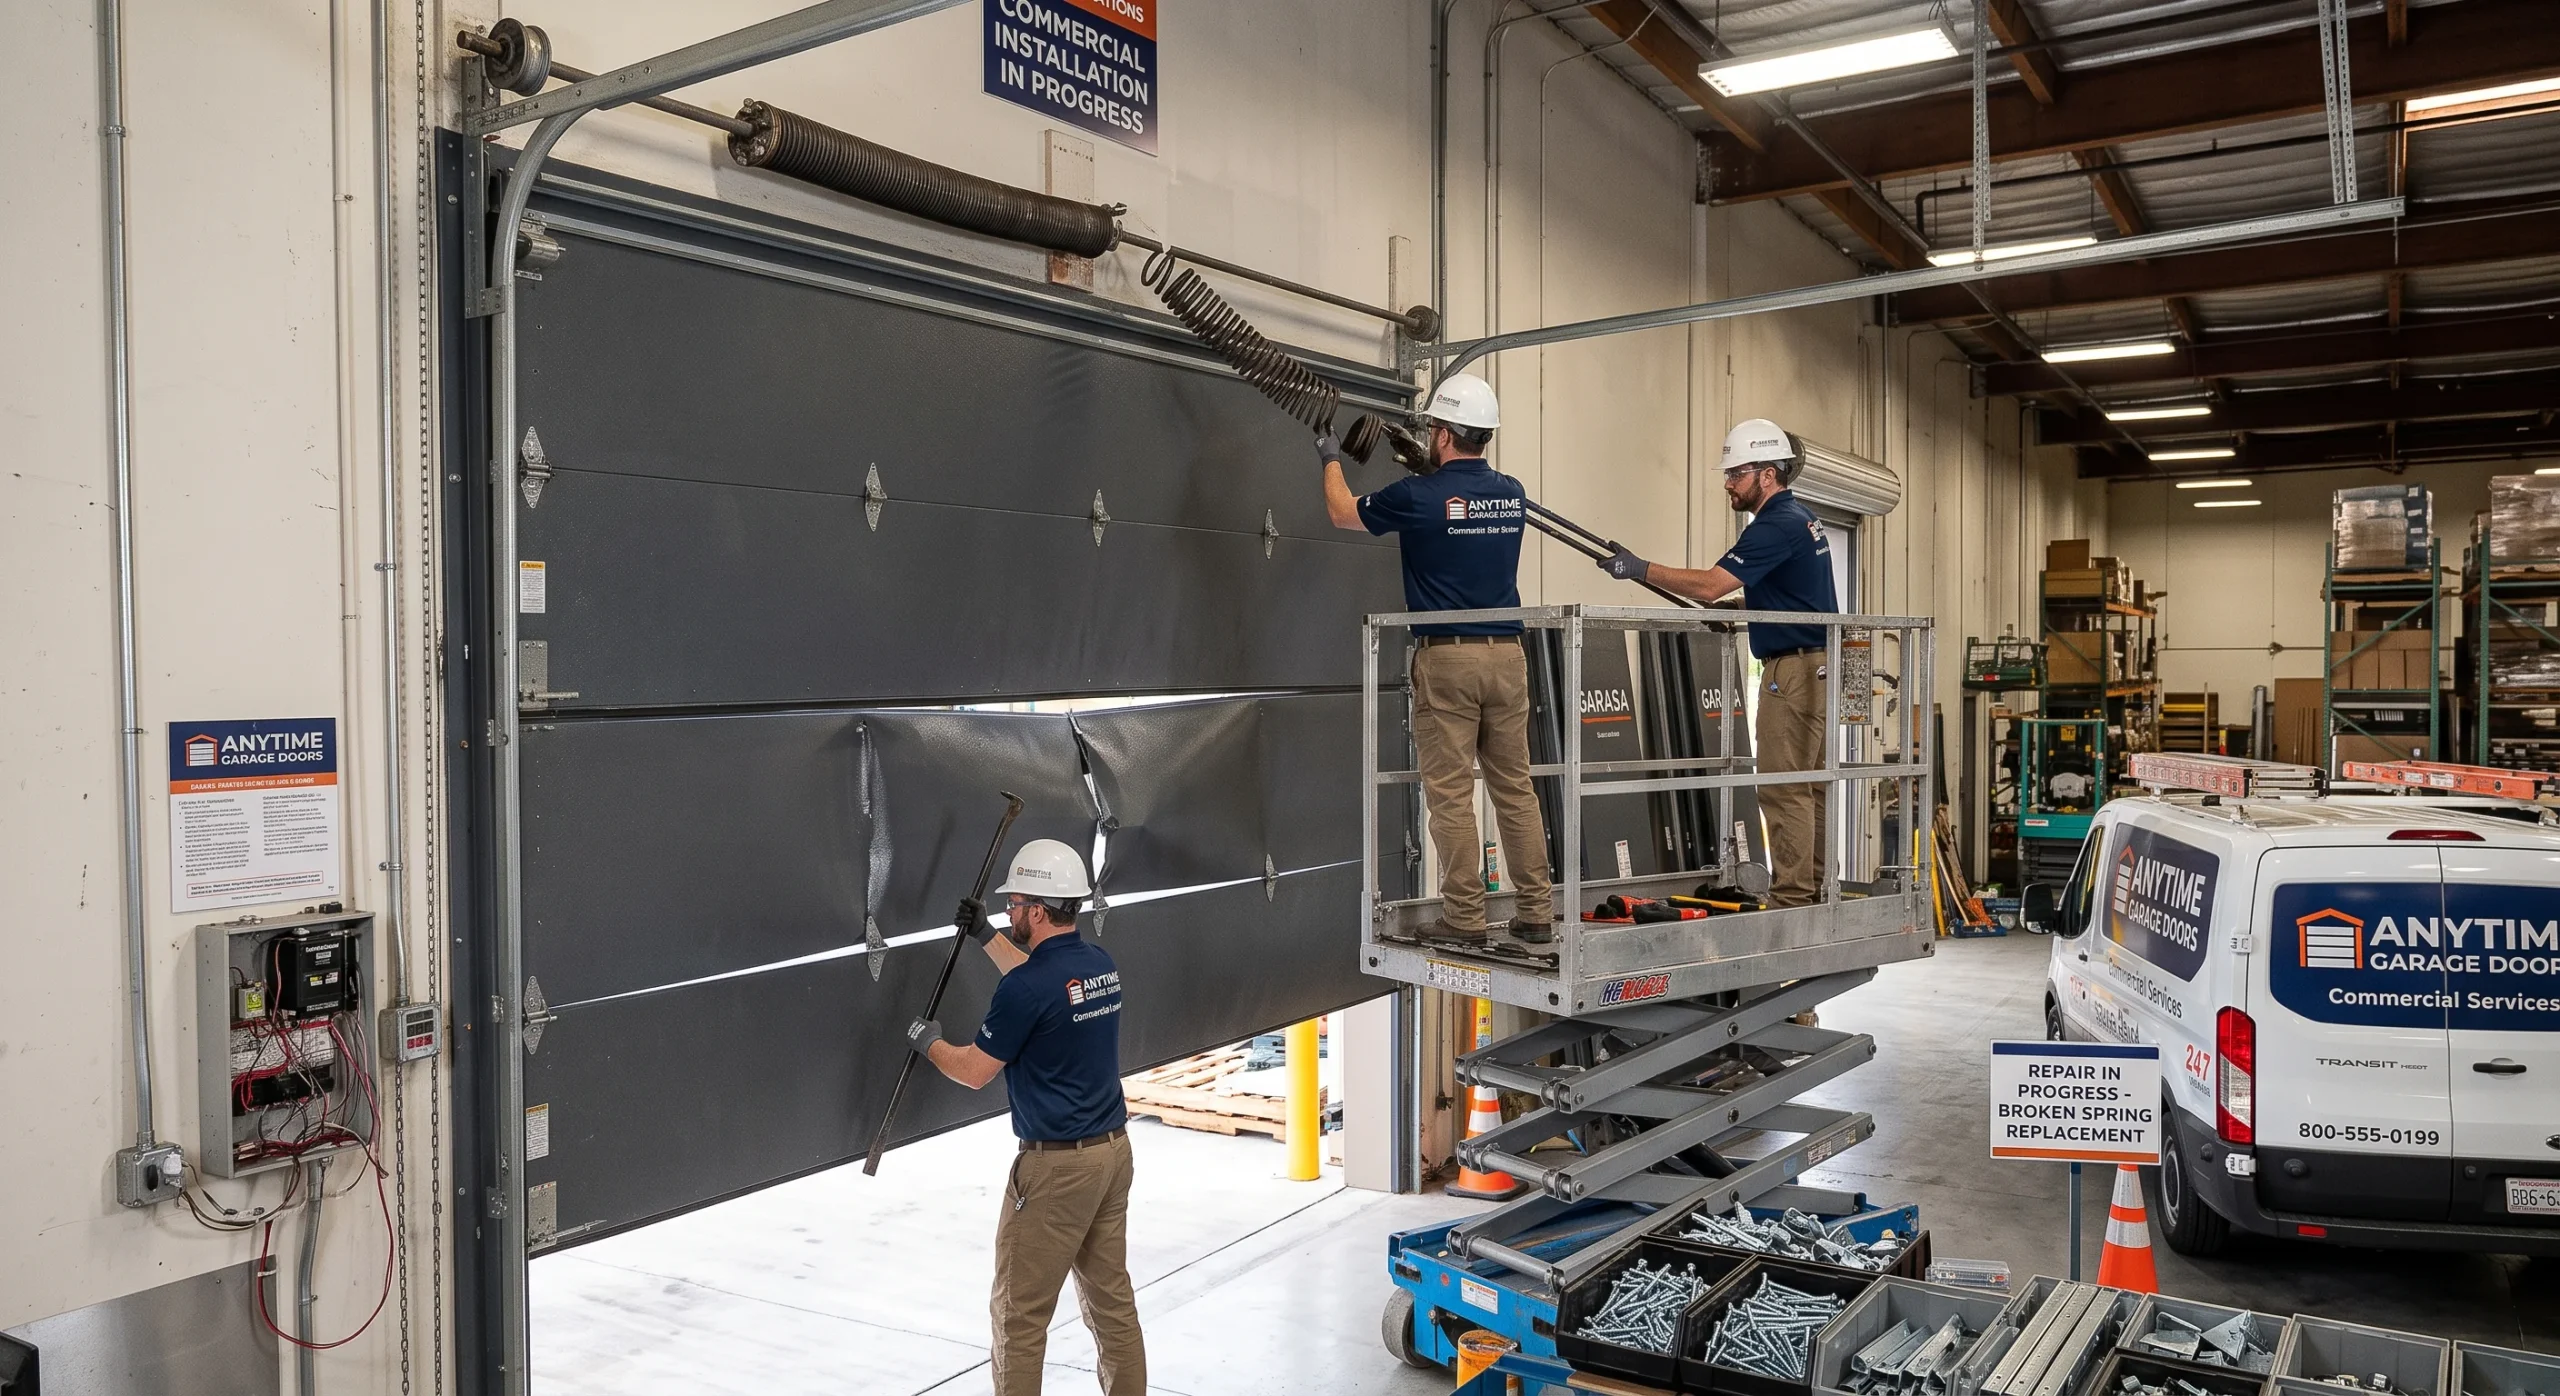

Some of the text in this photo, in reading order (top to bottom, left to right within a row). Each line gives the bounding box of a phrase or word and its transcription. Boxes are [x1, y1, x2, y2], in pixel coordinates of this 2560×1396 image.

[999, 0, 1145, 73] COMMERCIAL
[995, 22, 1148, 105] INSTALLATION
[1001, 58, 1144, 135] IN PROGRESS
[1468, 499, 1521, 511] ANYTIME
[1469, 511, 1499, 519] GARAGE
[1580, 689, 1629, 713] GARASA
[1702, 688, 1742, 709] GARA
[221, 732, 324, 752] ANYTIME
[221, 751, 323, 765] GARAGE DOORS
[2131, 855, 2206, 917] ANYTIME
[2128, 899, 2199, 952] GARAGE DOORS
[2370, 916, 2559, 951] ANYTIM
[2369, 952, 2481, 973] GARAGE
[2148, 979, 2182, 1019] Services
[2328, 987, 2560, 1012] Commercial Services
[2028, 1064, 2121, 1081] REPAIR IN
[2186, 1044, 2211, 1081] 247
[2315, 1057, 2398, 1069] TRANSIT
[2018, 1084, 2119, 1101] PROGRESS
[1998, 1103, 2152, 1122] BROKEN SPRING
[2006, 1124, 2145, 1143] REPLACEMENT
[2298, 1122, 2440, 1146] 800-555-0199
